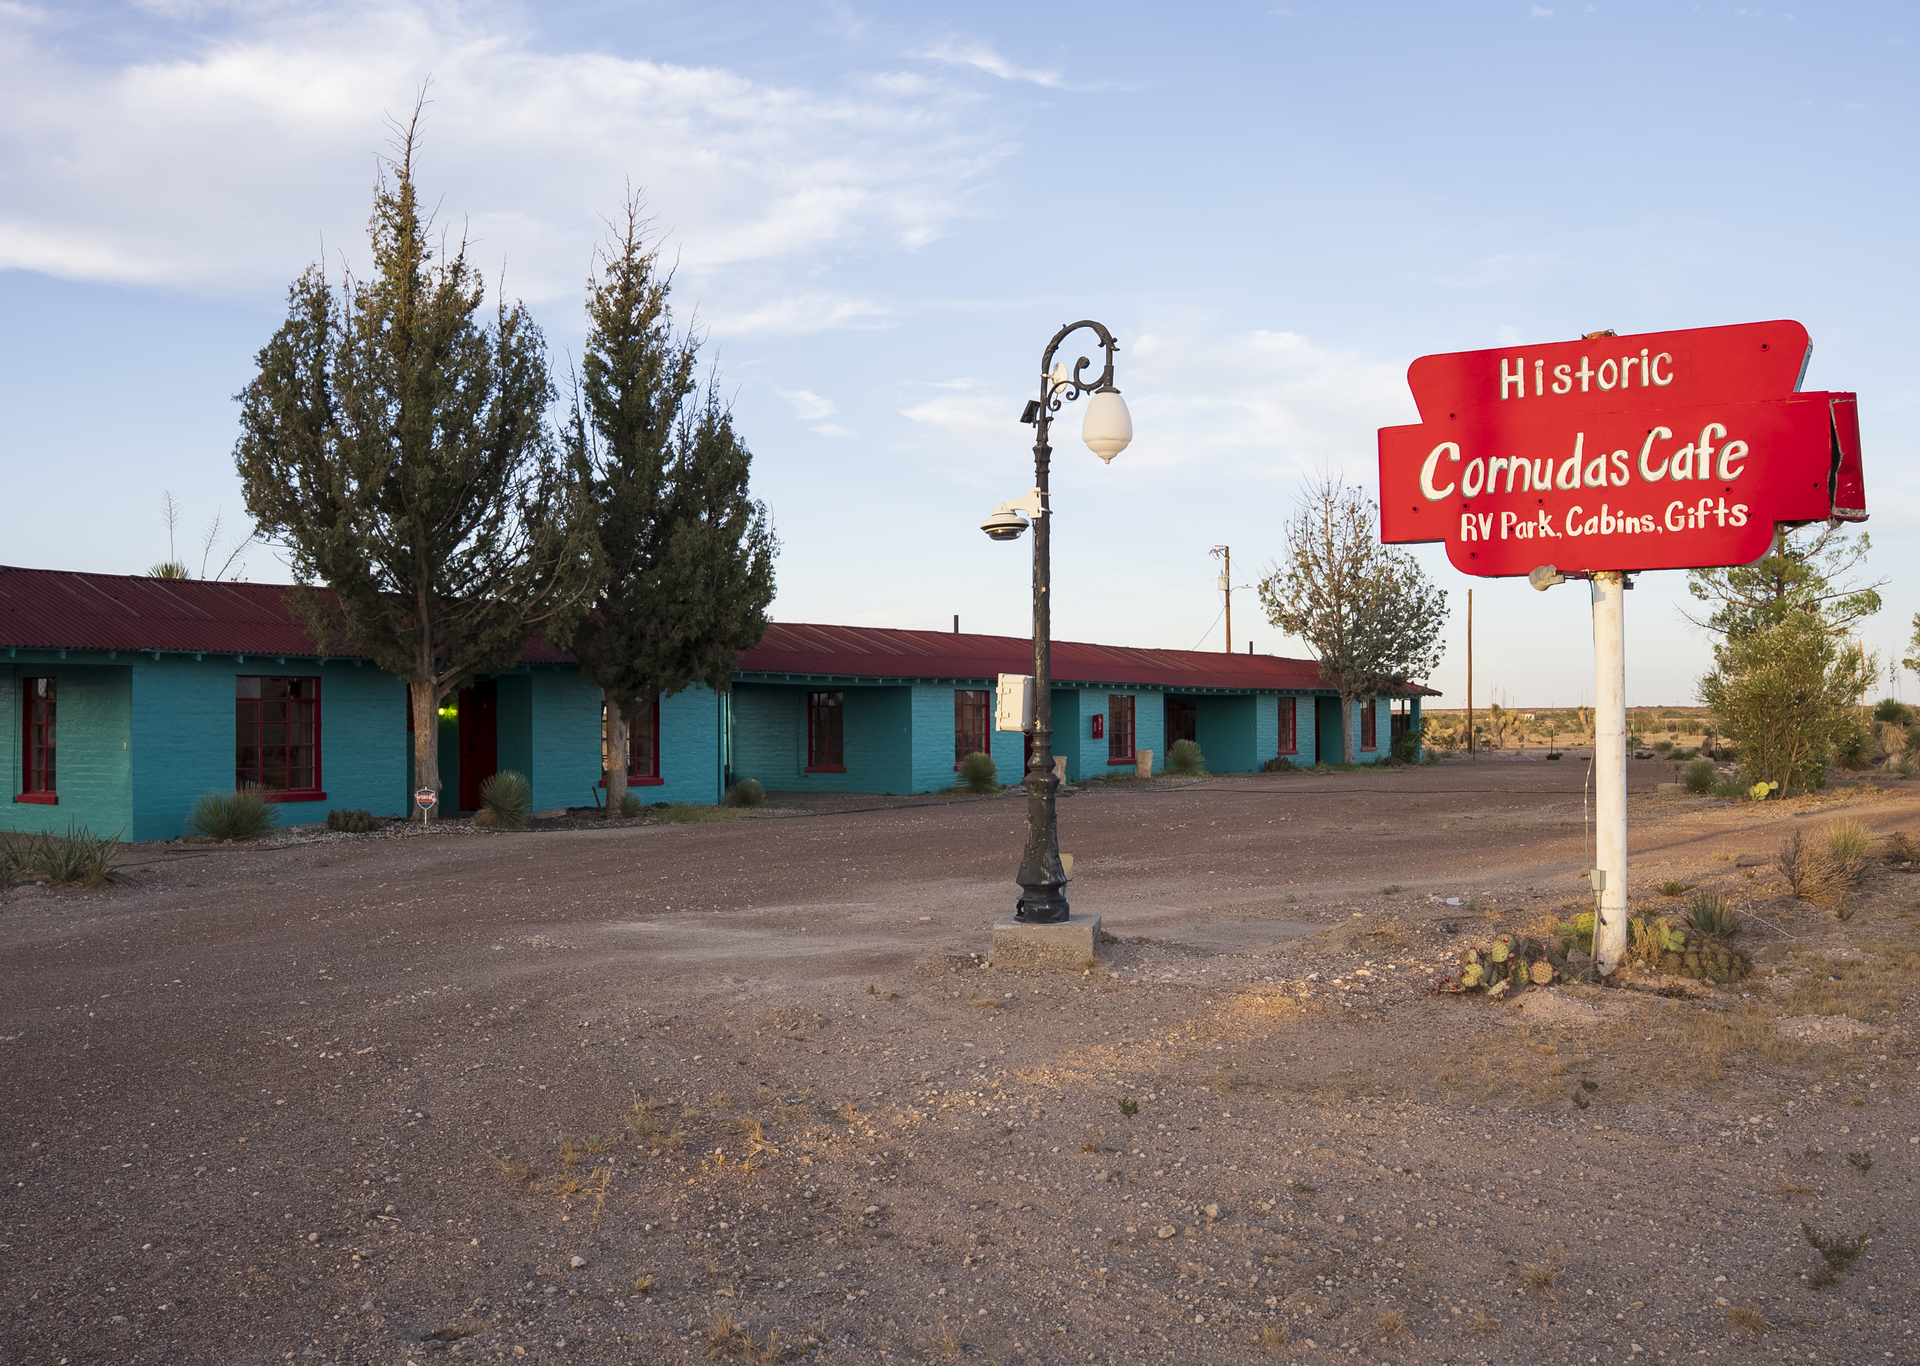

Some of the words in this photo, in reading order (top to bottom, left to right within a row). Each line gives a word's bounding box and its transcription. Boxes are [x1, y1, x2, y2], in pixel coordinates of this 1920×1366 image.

[1500, 347, 1675, 401] Historic
[1419, 432, 1631, 502] Cornudas
[1640, 422, 1750, 482] Cafe
[1460, 512, 1494, 542] RV
